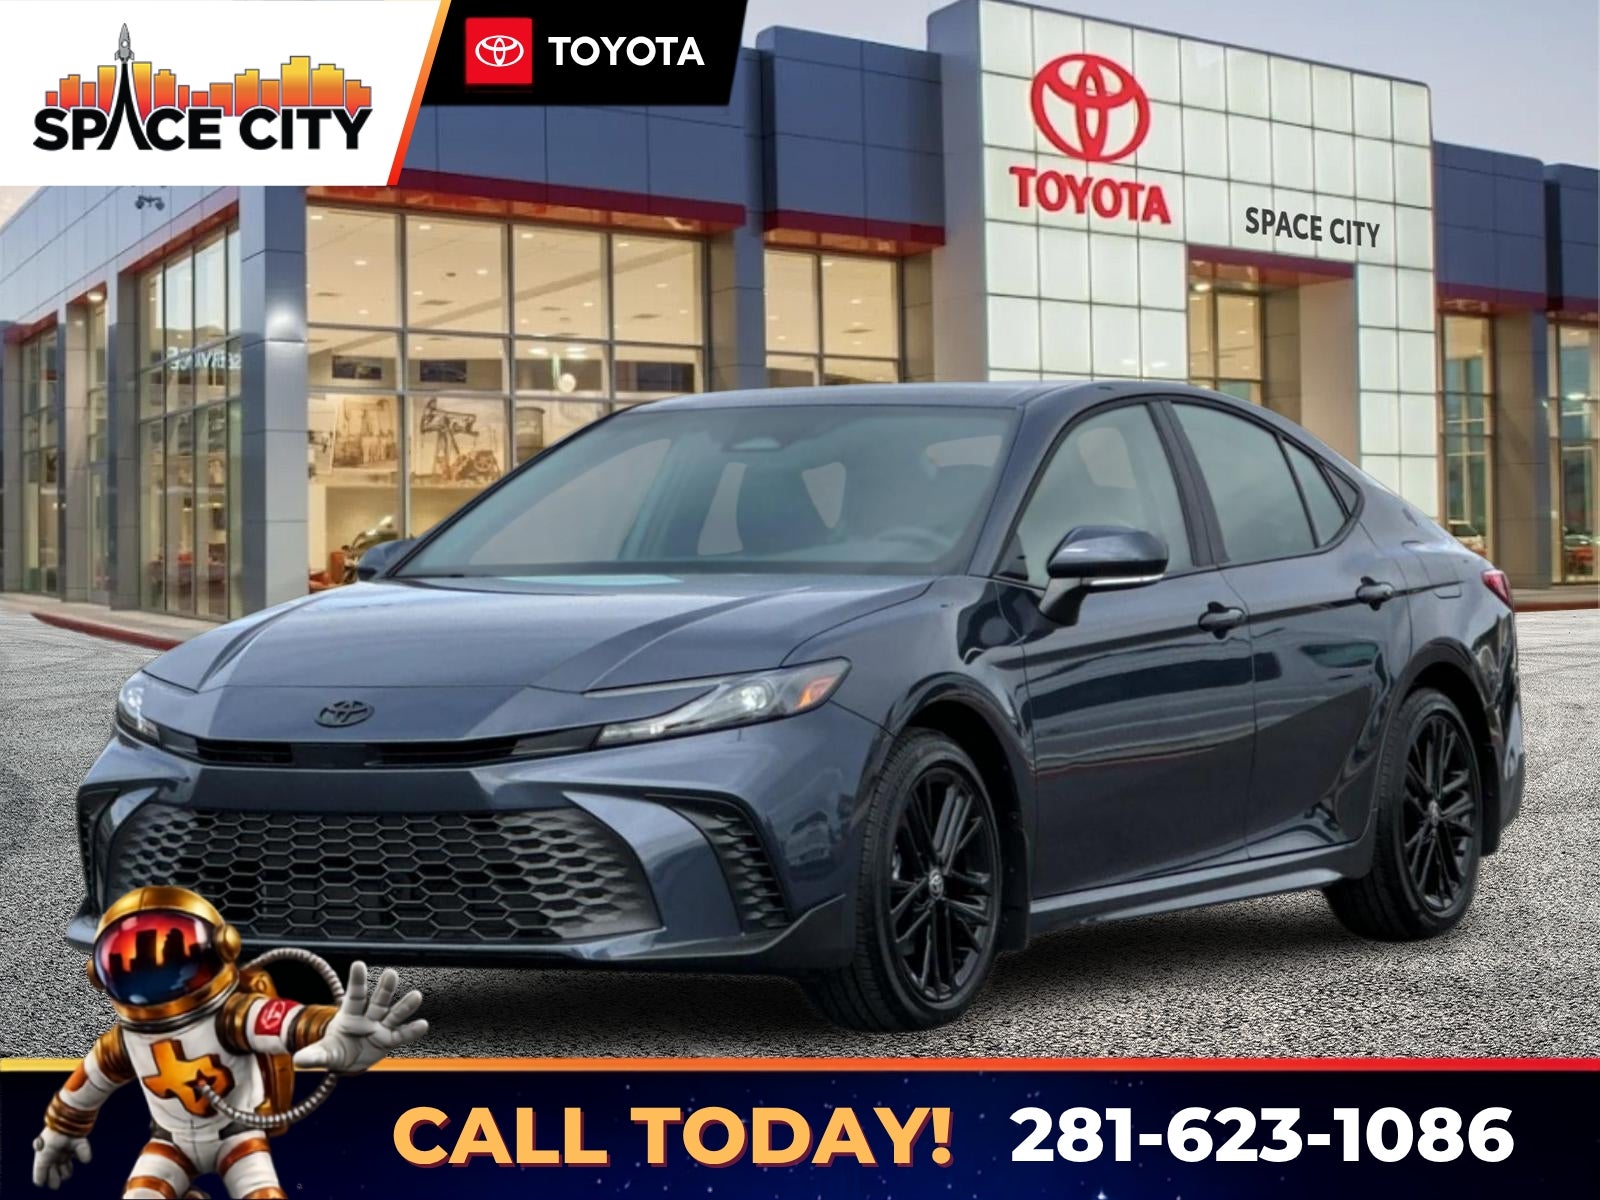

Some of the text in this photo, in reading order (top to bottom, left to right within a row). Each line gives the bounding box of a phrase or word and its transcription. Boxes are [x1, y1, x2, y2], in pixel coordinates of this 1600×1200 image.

[1009, 166, 1172, 224] TOYOTA
[1245, 206, 1381, 248] SPACE CITY
